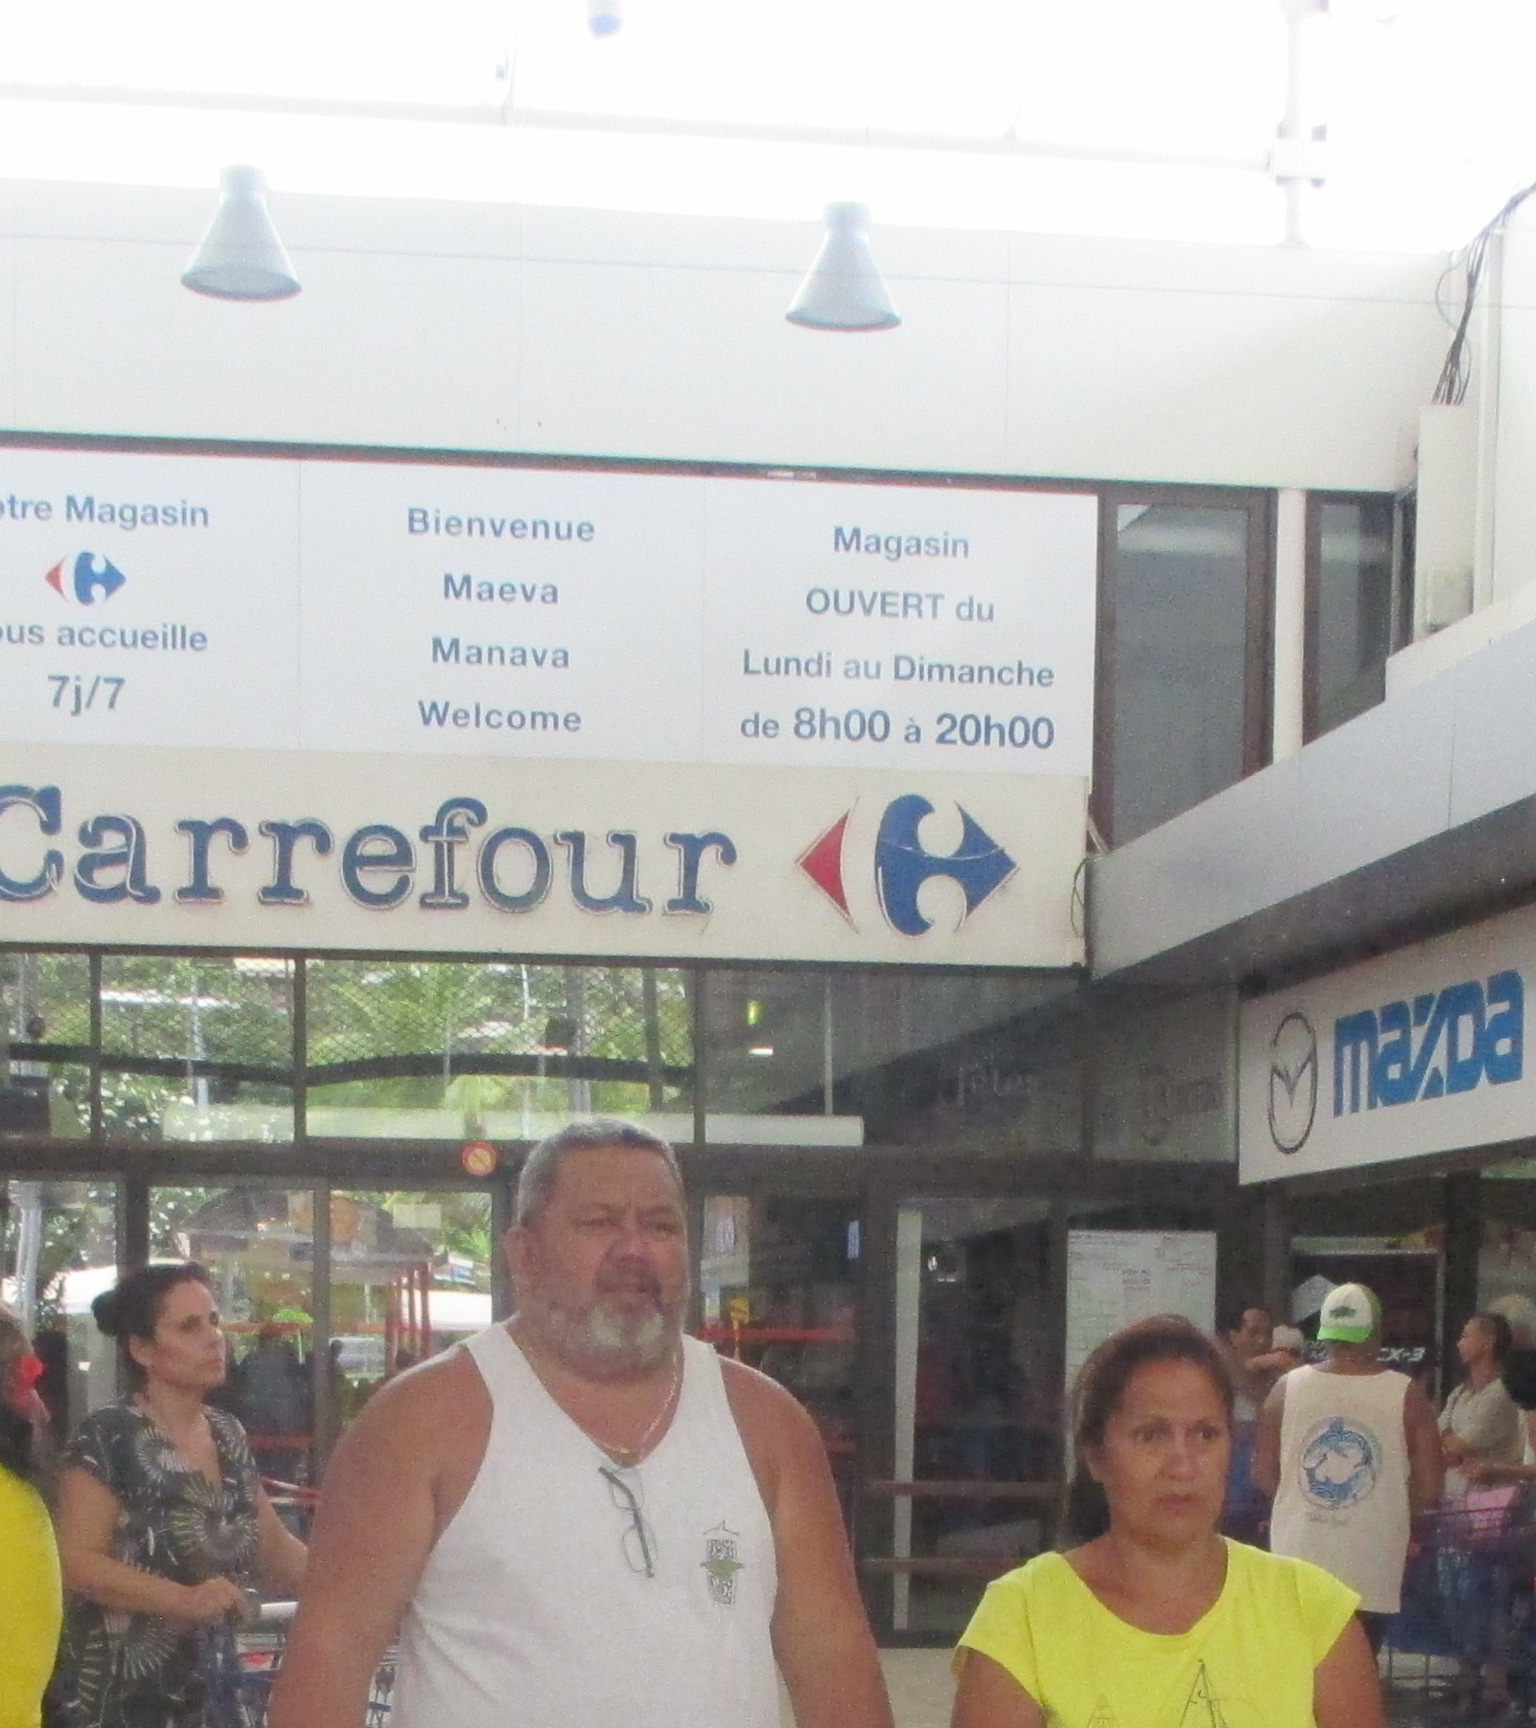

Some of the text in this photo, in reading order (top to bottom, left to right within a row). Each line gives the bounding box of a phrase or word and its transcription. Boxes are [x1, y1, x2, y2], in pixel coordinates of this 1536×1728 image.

[65, 494, 210, 532] Magasin
[407, 506, 596, 543] Bienvenue
[833, 525, 970, 563] Magasin
[443, 573, 560, 605] Maeva
[805, 587, 996, 624] OUVERT du
[55, 622, 209, 653] accueille
[431, 636, 571, 670] Manava
[742, 648, 1056, 690] Lundi au Dimanche
[48, 673, 126, 716] 7j/7
[418, 700, 583, 735] Welcome
[740, 706, 1056, 751] de 8h00 à 20h00
[1332, 968, 1523, 1118] mazda
